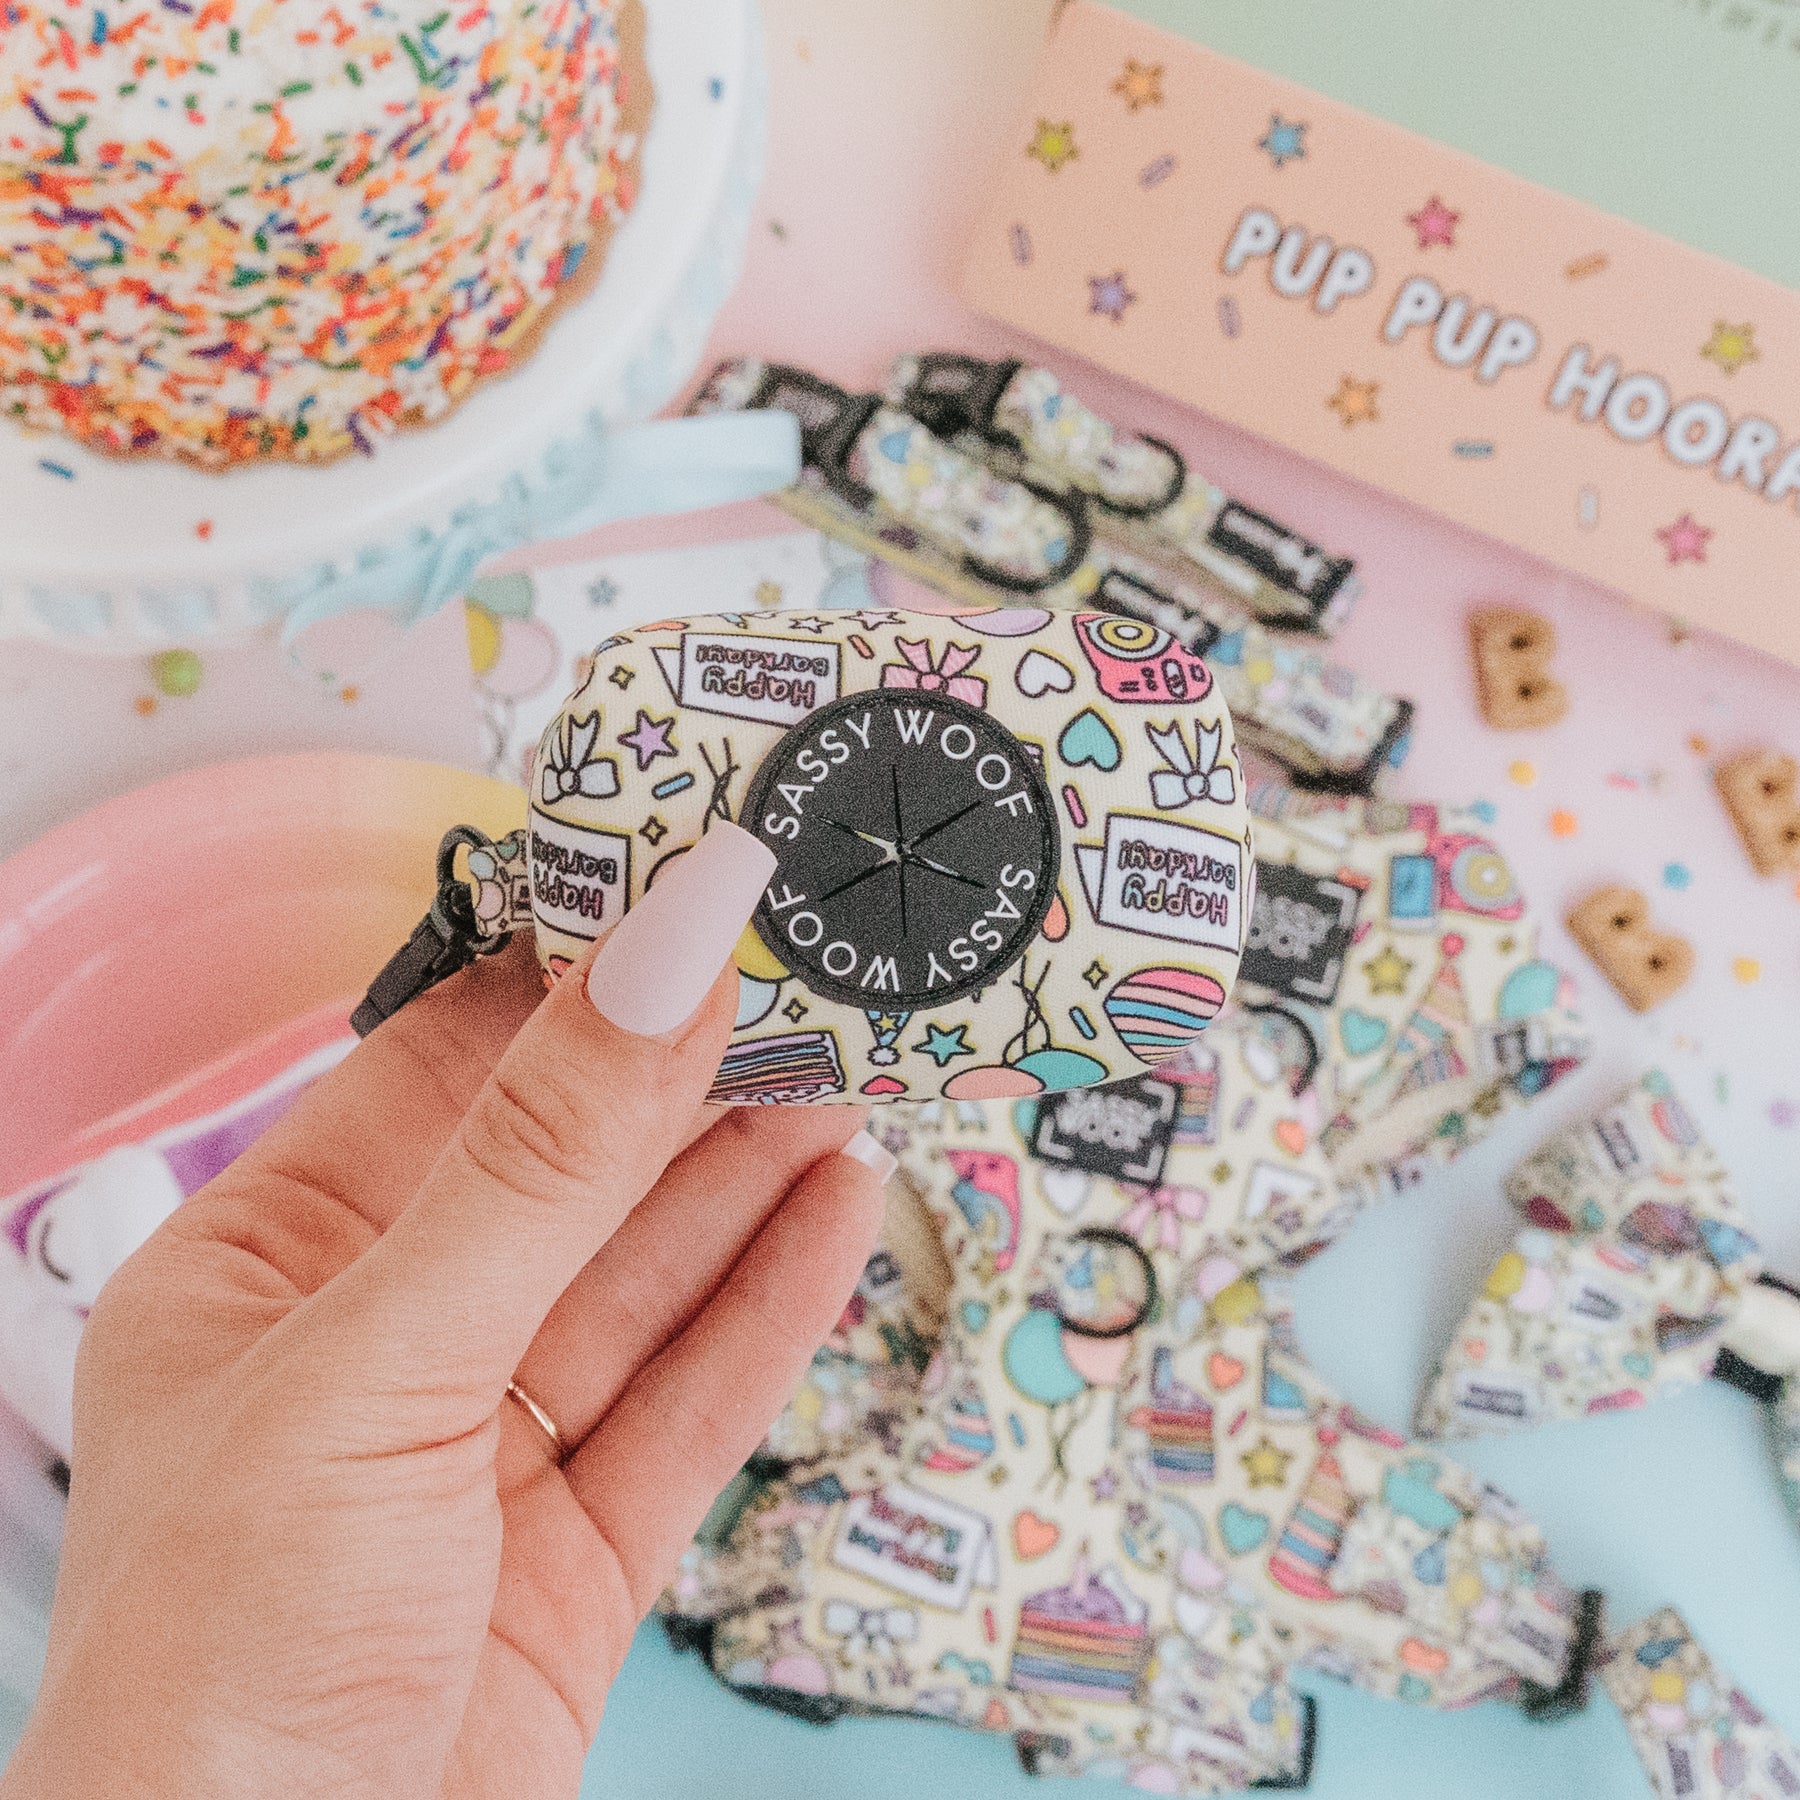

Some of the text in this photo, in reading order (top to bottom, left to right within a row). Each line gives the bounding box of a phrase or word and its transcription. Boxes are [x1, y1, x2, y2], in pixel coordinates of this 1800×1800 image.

[1221, 209, 1374, 314] PUP
[1383, 278, 1538, 383] PUP
[702, 665, 816, 710] Happy
[764, 708, 1034, 840] SASSY WOOF
[766, 863, 1036, 992] SASSY WOOF
[1120, 873, 1229, 927] Happy
